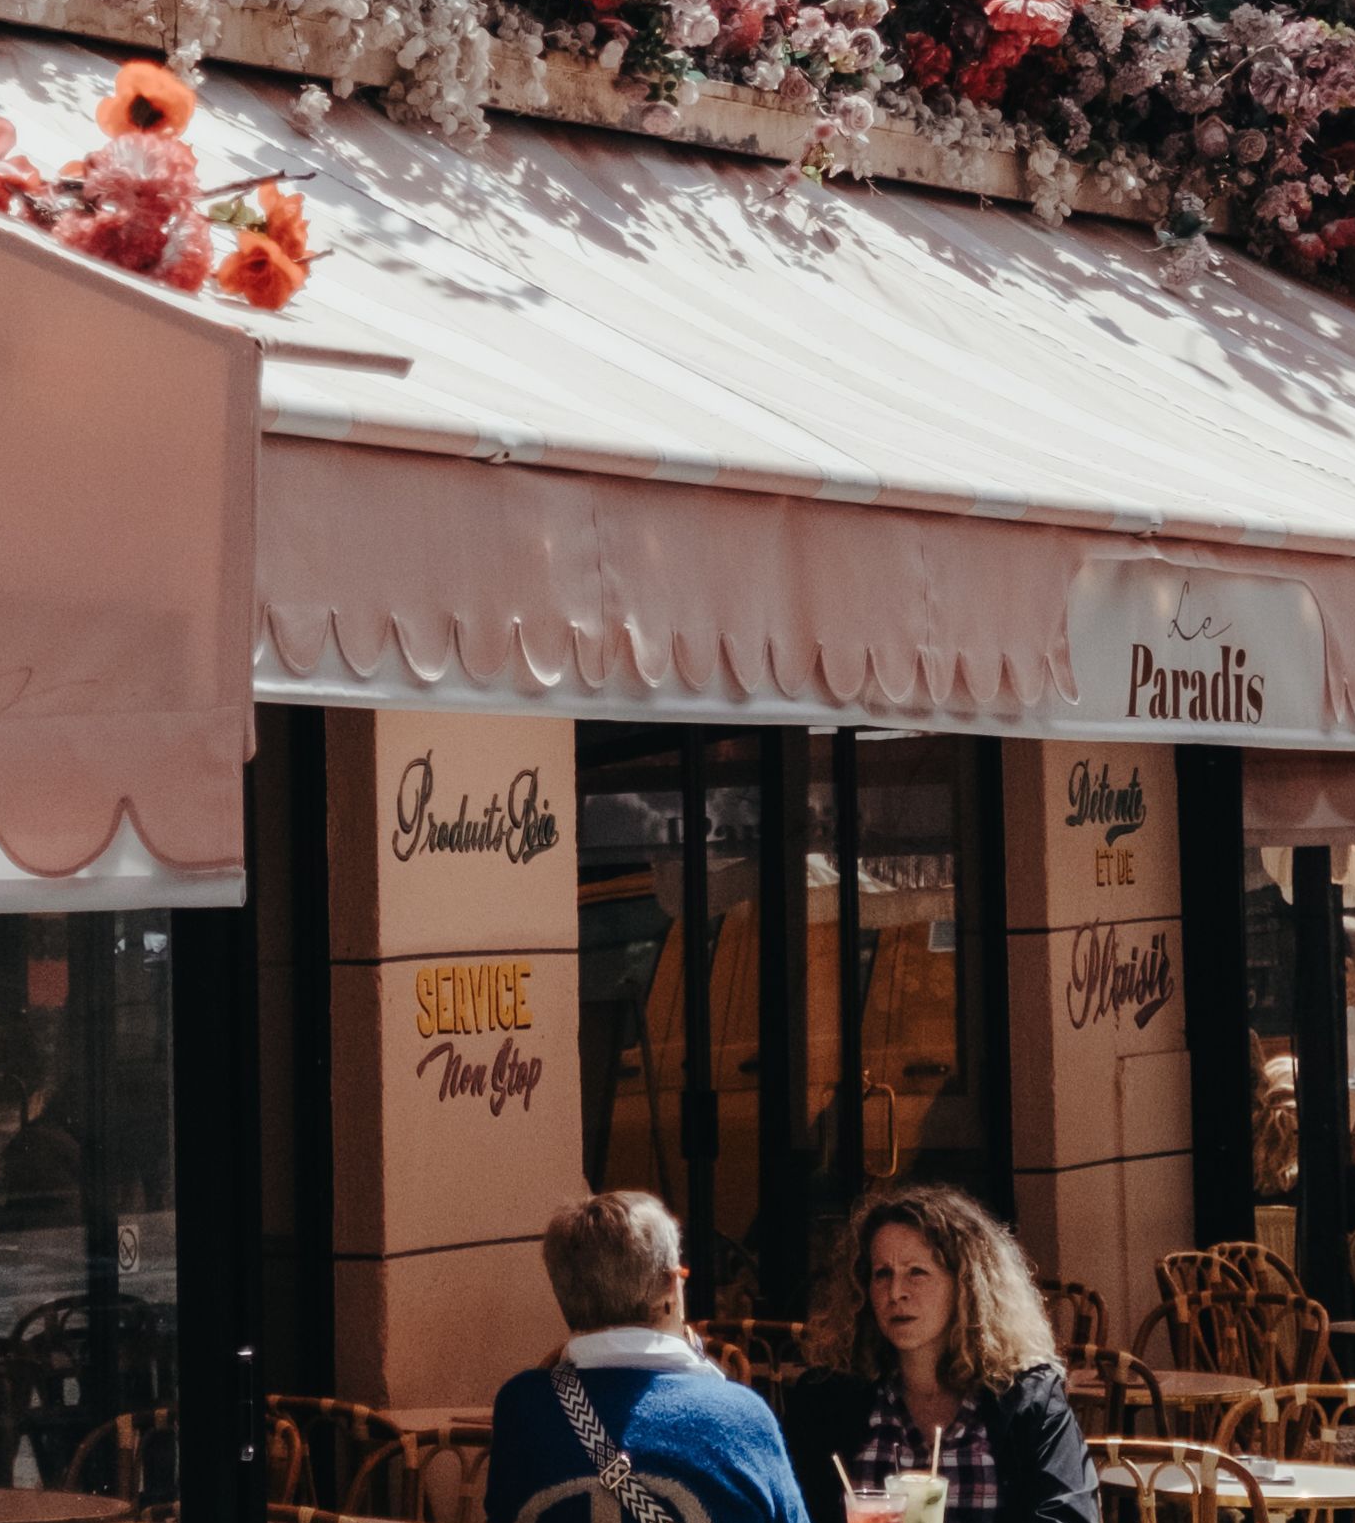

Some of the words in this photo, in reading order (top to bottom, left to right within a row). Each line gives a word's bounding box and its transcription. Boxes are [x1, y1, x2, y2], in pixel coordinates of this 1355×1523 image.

[1167, 580, 1233, 642] Le
[1125, 643, 1265, 725] Paradis
[391, 748, 507, 863] Produits
[506, 766, 560, 865] Bio
[1065, 758, 1147, 847] Détente
[1096, 849, 1114, 887] ET
[1117, 849, 1136, 886] DE
[415, 961, 532, 1039] SERVICE
[1066, 916, 1175, 1031] Plaisir
[416, 1041, 488, 1103] Non
[489, 1037, 543, 1118] Stop
